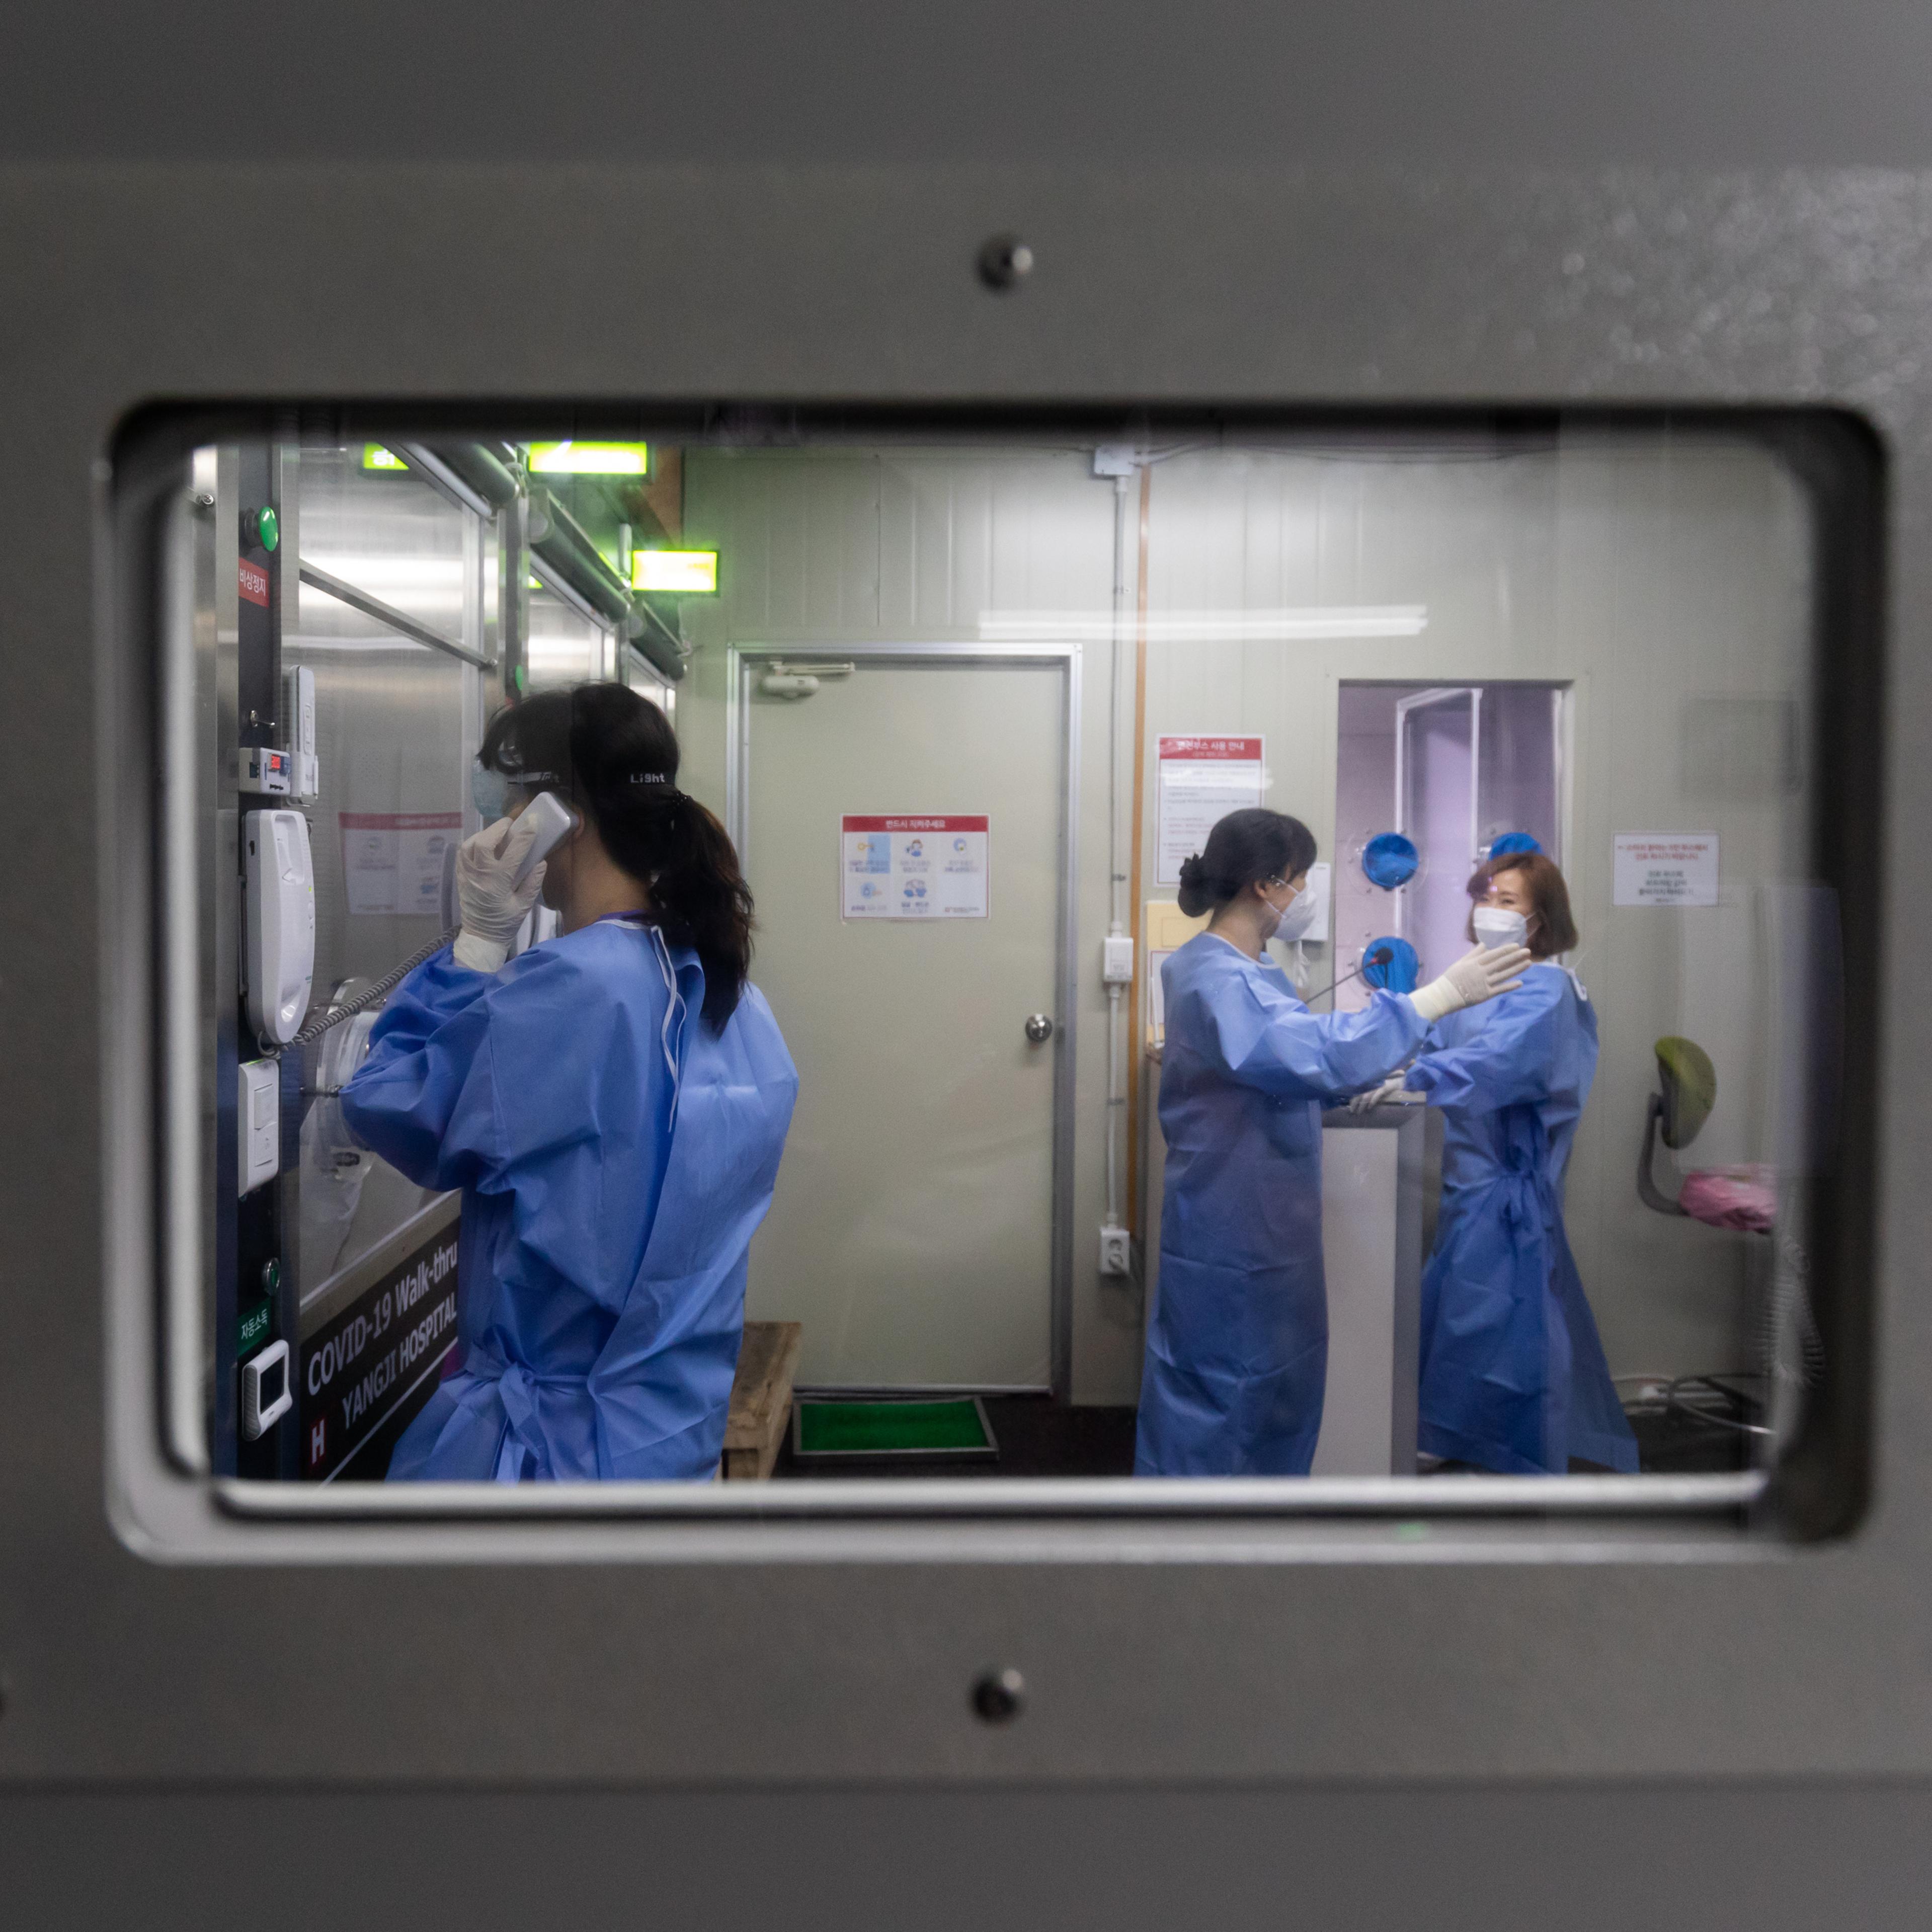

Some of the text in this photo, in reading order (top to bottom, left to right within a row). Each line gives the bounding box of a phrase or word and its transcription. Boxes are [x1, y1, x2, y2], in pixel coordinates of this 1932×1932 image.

[239, 569, 266, 597] 비상정지
[630, 773, 665, 783] Light
[886, 819, 945, 829] 반드시 지켜주세요
[241, 1308, 268, 1340] 자동소독
[307, 1241, 458, 1396] COVID-19 Walk-thru
[311, 1292, 457, 1465] H YANGJI HOSPITAL
